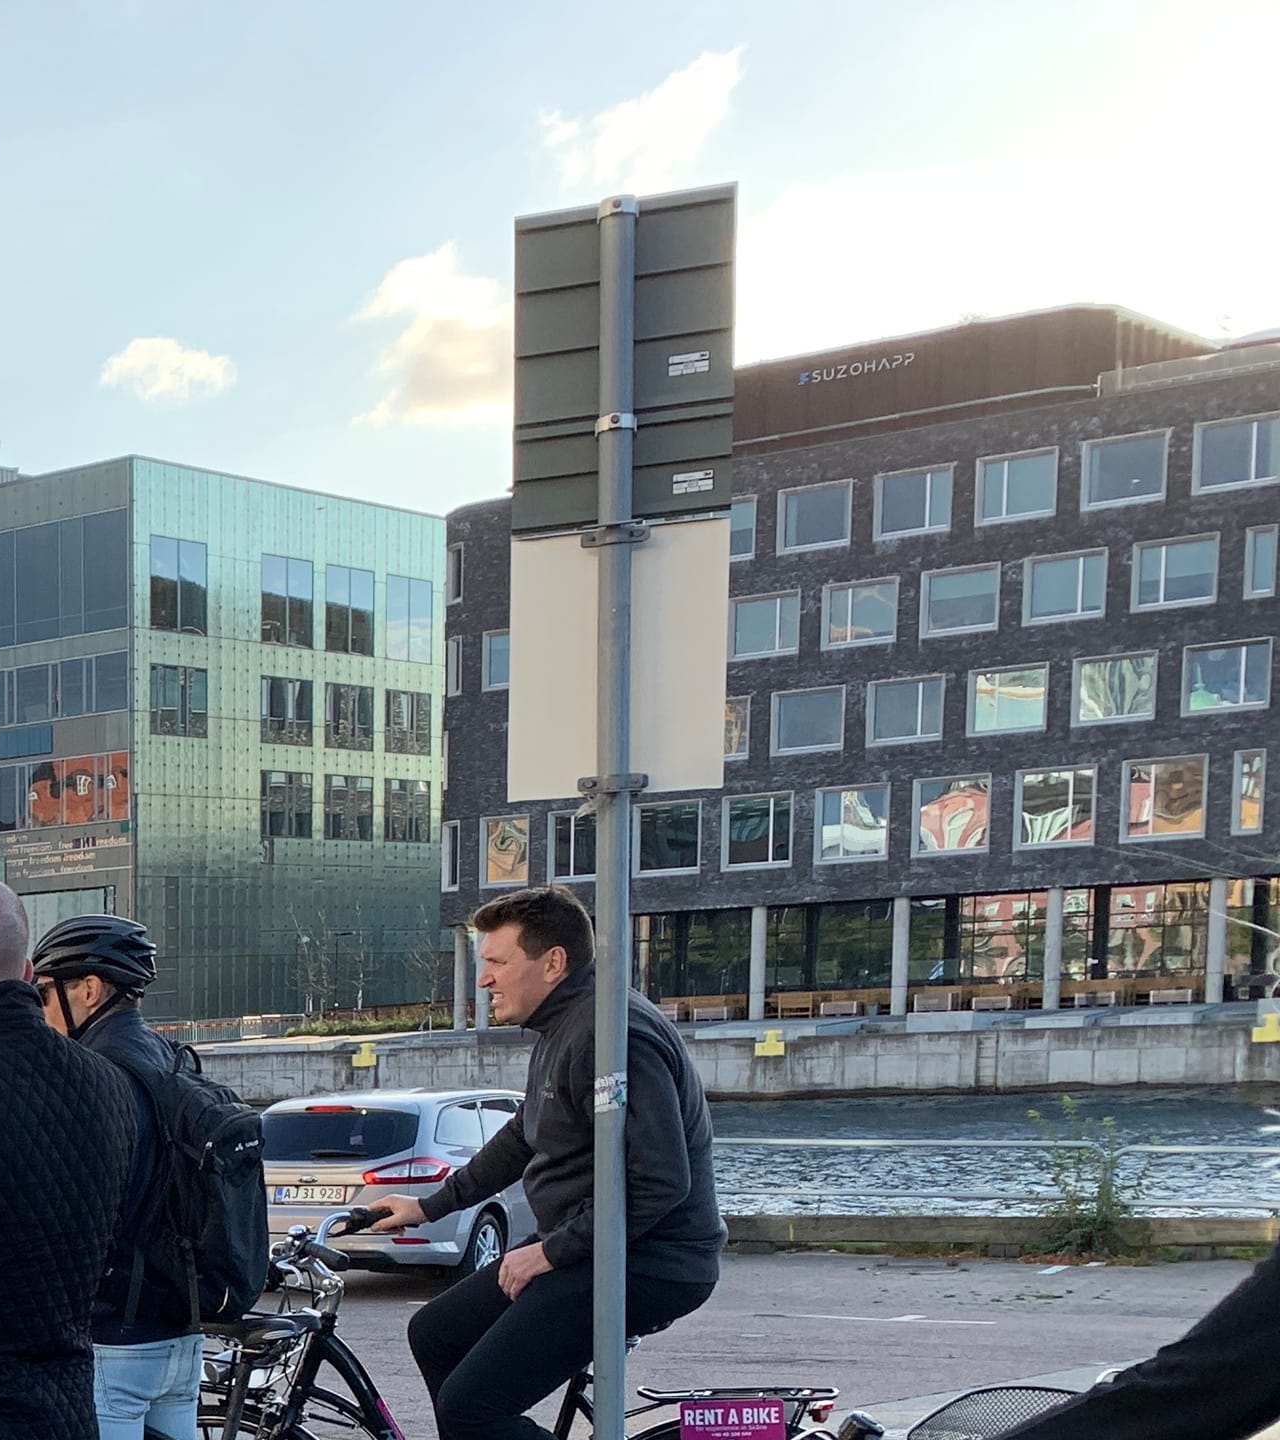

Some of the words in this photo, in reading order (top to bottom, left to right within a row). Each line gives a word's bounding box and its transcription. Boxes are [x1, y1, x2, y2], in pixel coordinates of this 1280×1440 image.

[811, 353, 915, 383] SUZOHAPP
[284, 1188, 299, 1199] AJ
[303, 1188, 315, 1199] 31
[320, 1188, 343, 1199] 928
[684, 1408, 724, 1426] RENT
[728, 1408, 739, 1425] A
[742, 1407, 780, 1425] BIKE
